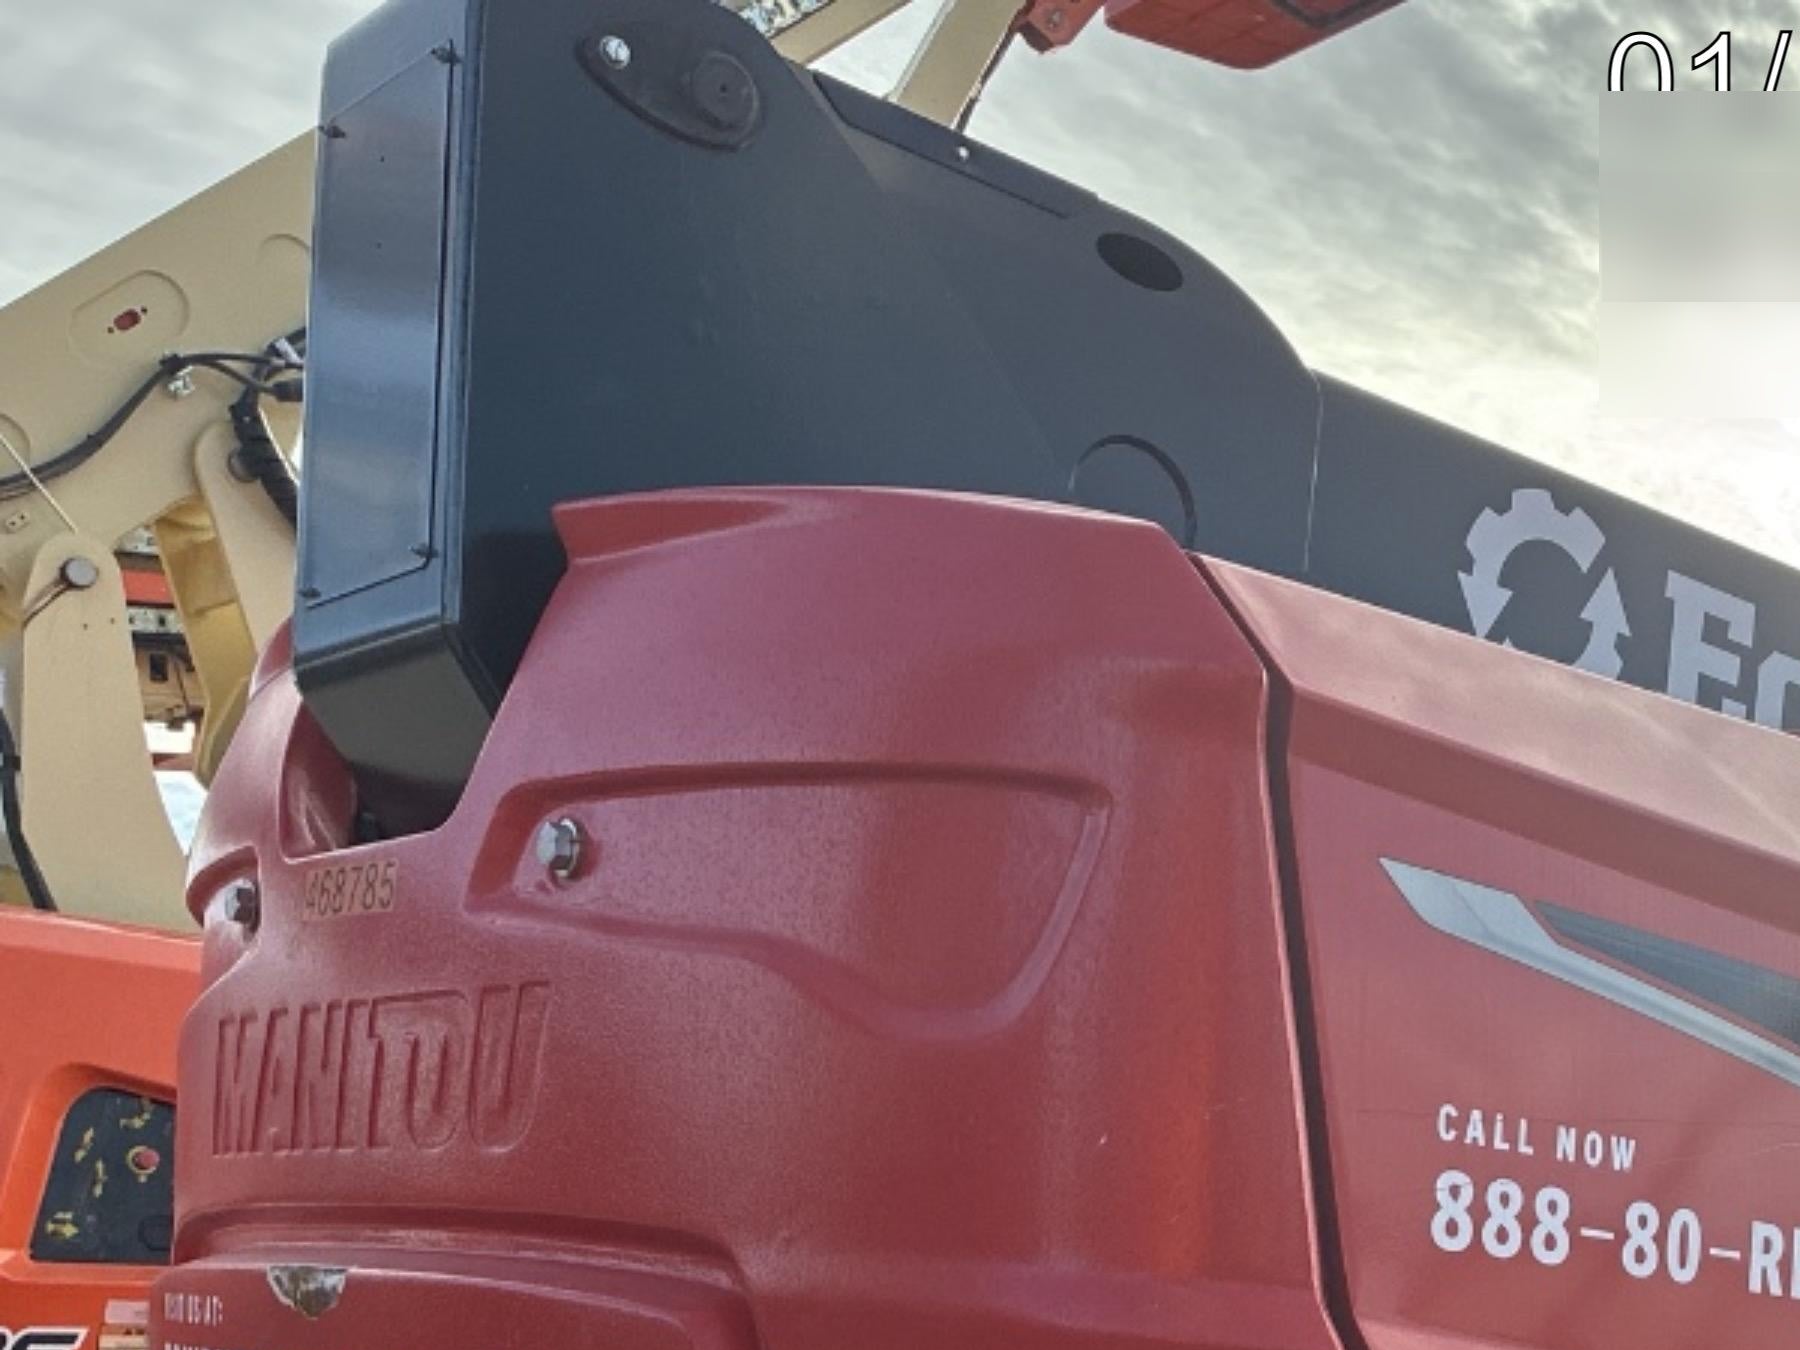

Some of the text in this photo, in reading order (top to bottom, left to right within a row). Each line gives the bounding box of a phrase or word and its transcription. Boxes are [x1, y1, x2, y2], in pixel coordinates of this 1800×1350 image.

[305, 860, 396, 917] 468785
[212, 980, 549, 1156] MANITOU
[1437, 1104, 1637, 1172] CALL NOW
